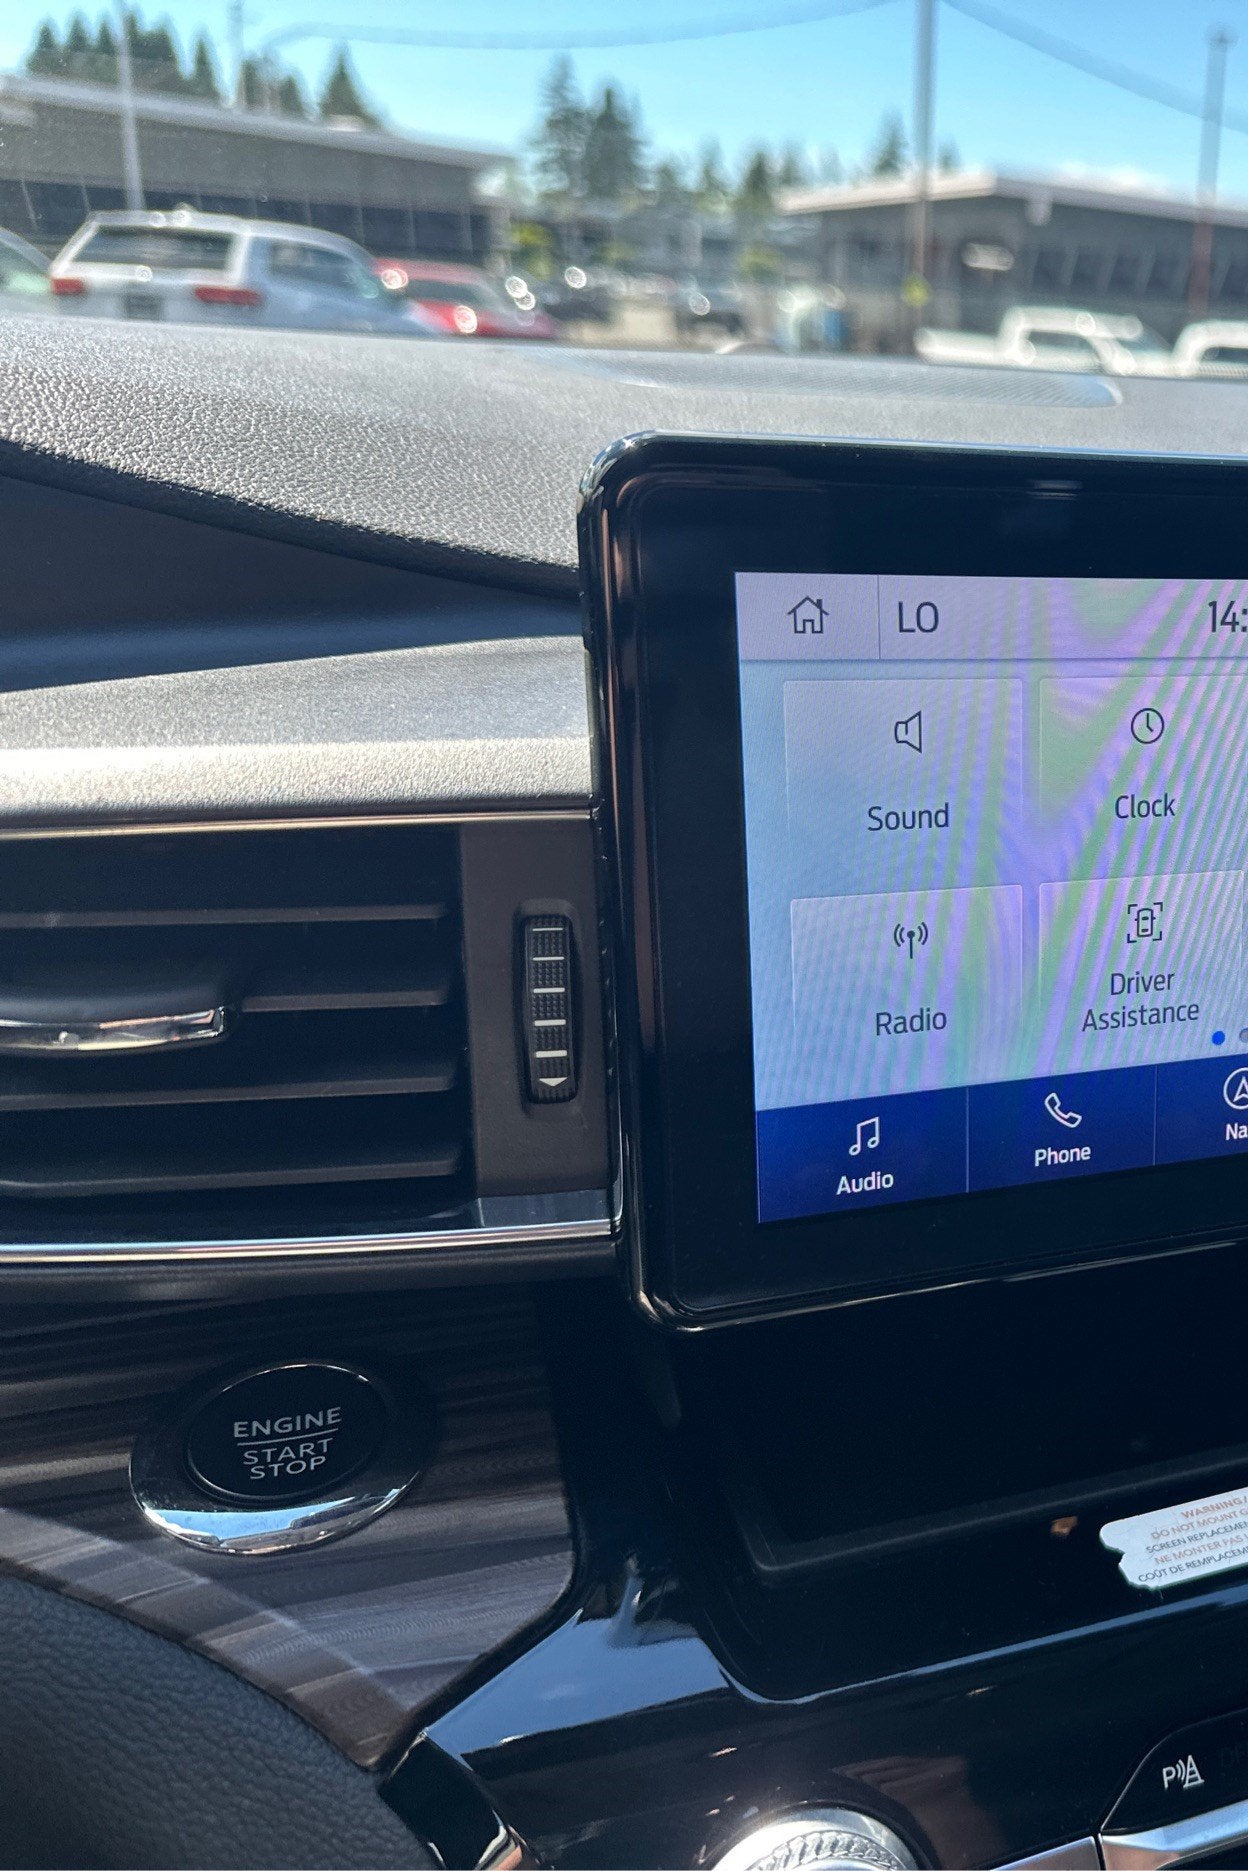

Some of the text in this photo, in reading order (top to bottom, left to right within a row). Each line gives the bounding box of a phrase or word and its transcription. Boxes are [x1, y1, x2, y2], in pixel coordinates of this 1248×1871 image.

[897, 600, 940, 634] LO
[867, 802, 950, 833] Sound
[1114, 793, 1176, 820] Clock
[1110, 969, 1176, 997] Driver
[875, 1006, 948, 1037] Radio
[1080, 1000, 1201, 1033] Assistance
[1033, 1143, 1092, 1168] Phone
[835, 1170, 896, 1196] Audio
[233, 1406, 343, 1439] ENGINE
[243, 1437, 334, 1466] START
[249, 1455, 328, 1481] STOP
[1150, 1528, 1171, 1541] DO
[1171, 1521, 1197, 1535] NOT
[1196, 1509, 1240, 1529] MOUNT
[1145, 1537, 1188, 1554] SCREEN
[1153, 1553, 1173, 1565] NE
[1172, 1540, 1224, 1561] MONTER
[1223, 1534, 1245, 1547] PAS
[1138, 1567, 1169, 1583] COÛT
[1168, 1562, 1186, 1575] DE
